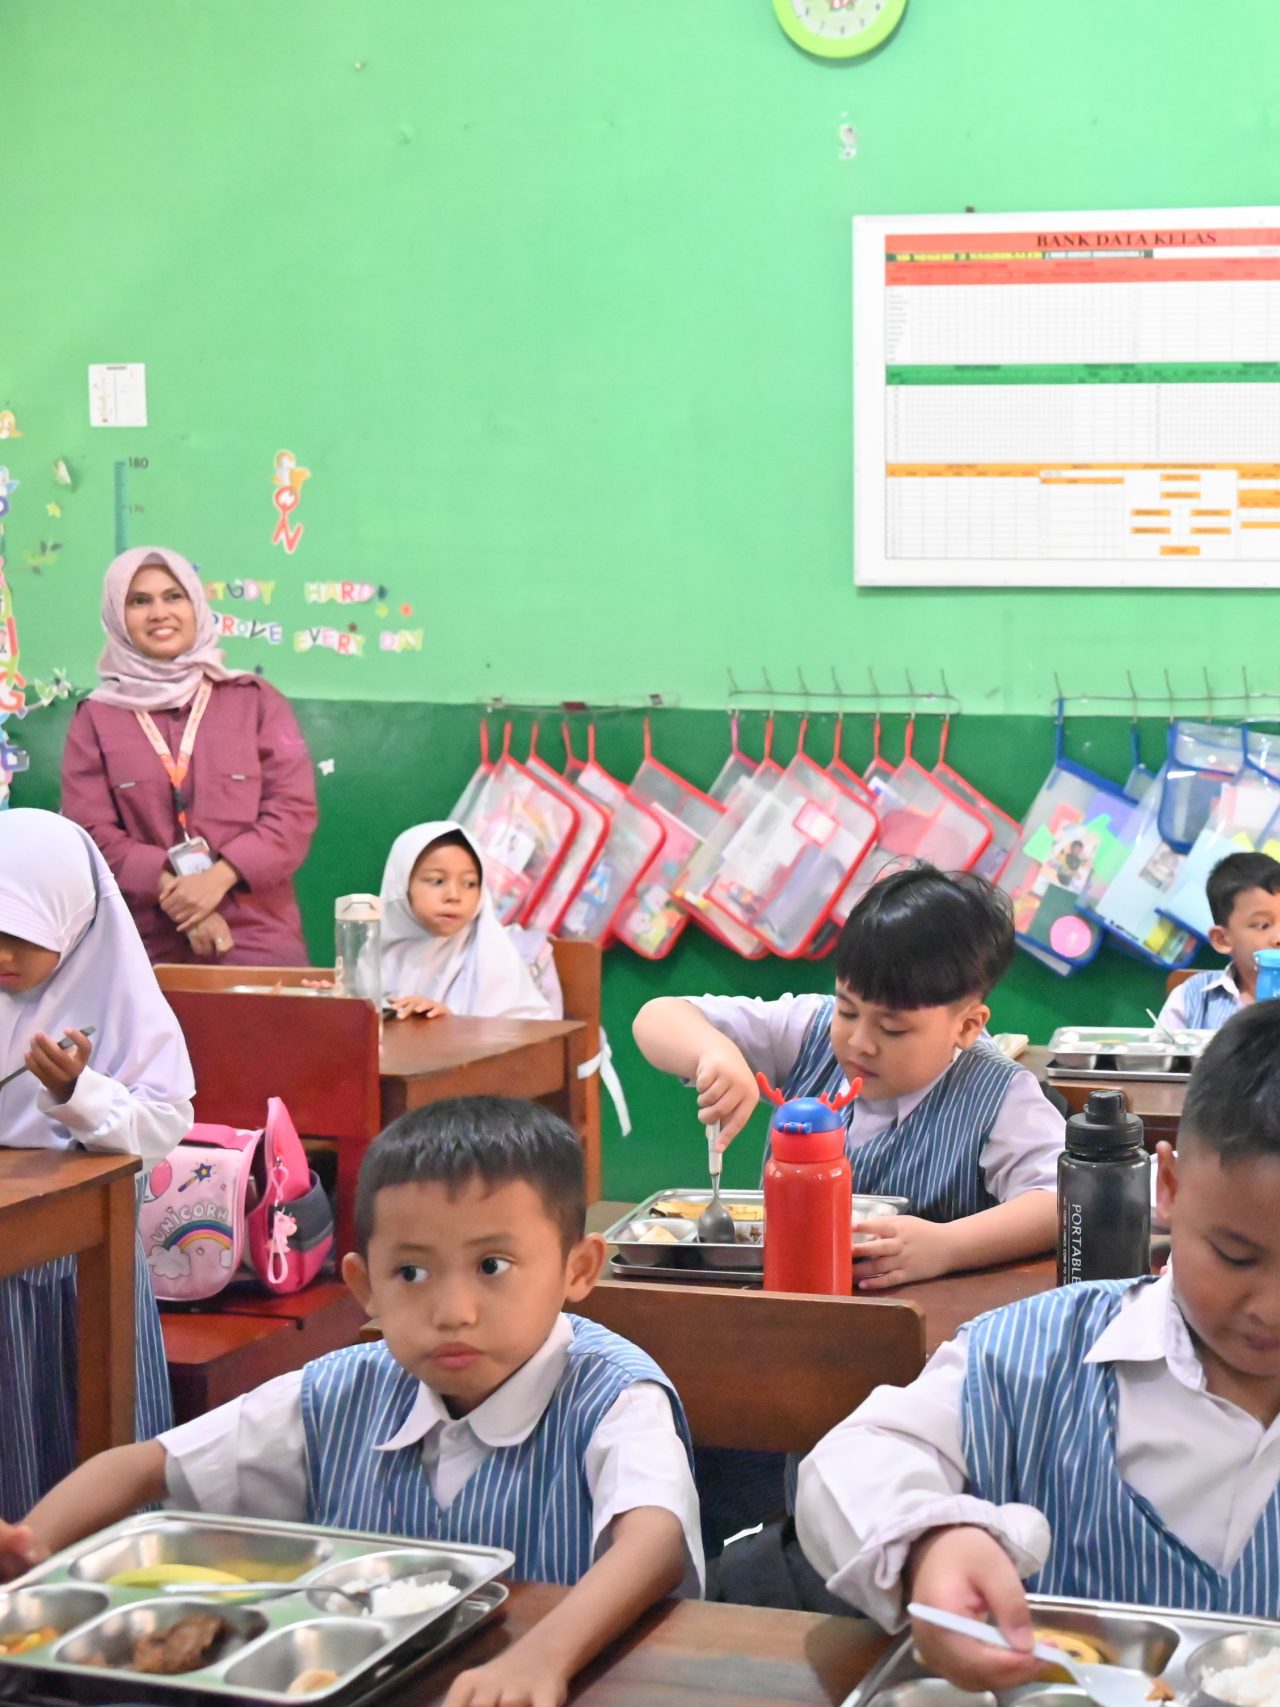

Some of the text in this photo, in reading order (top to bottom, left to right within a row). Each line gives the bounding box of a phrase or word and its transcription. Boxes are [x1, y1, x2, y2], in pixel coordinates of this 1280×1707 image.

[1036, 234, 1090, 248] BANK
[1097, 233, 1148, 247] DATA
[1154, 232, 1217, 246] KELAS
[128, 457, 149, 469] 180
[151, 1203, 228, 1243] UNICORN
[1071, 1203, 1082, 1284] PORTABLE
